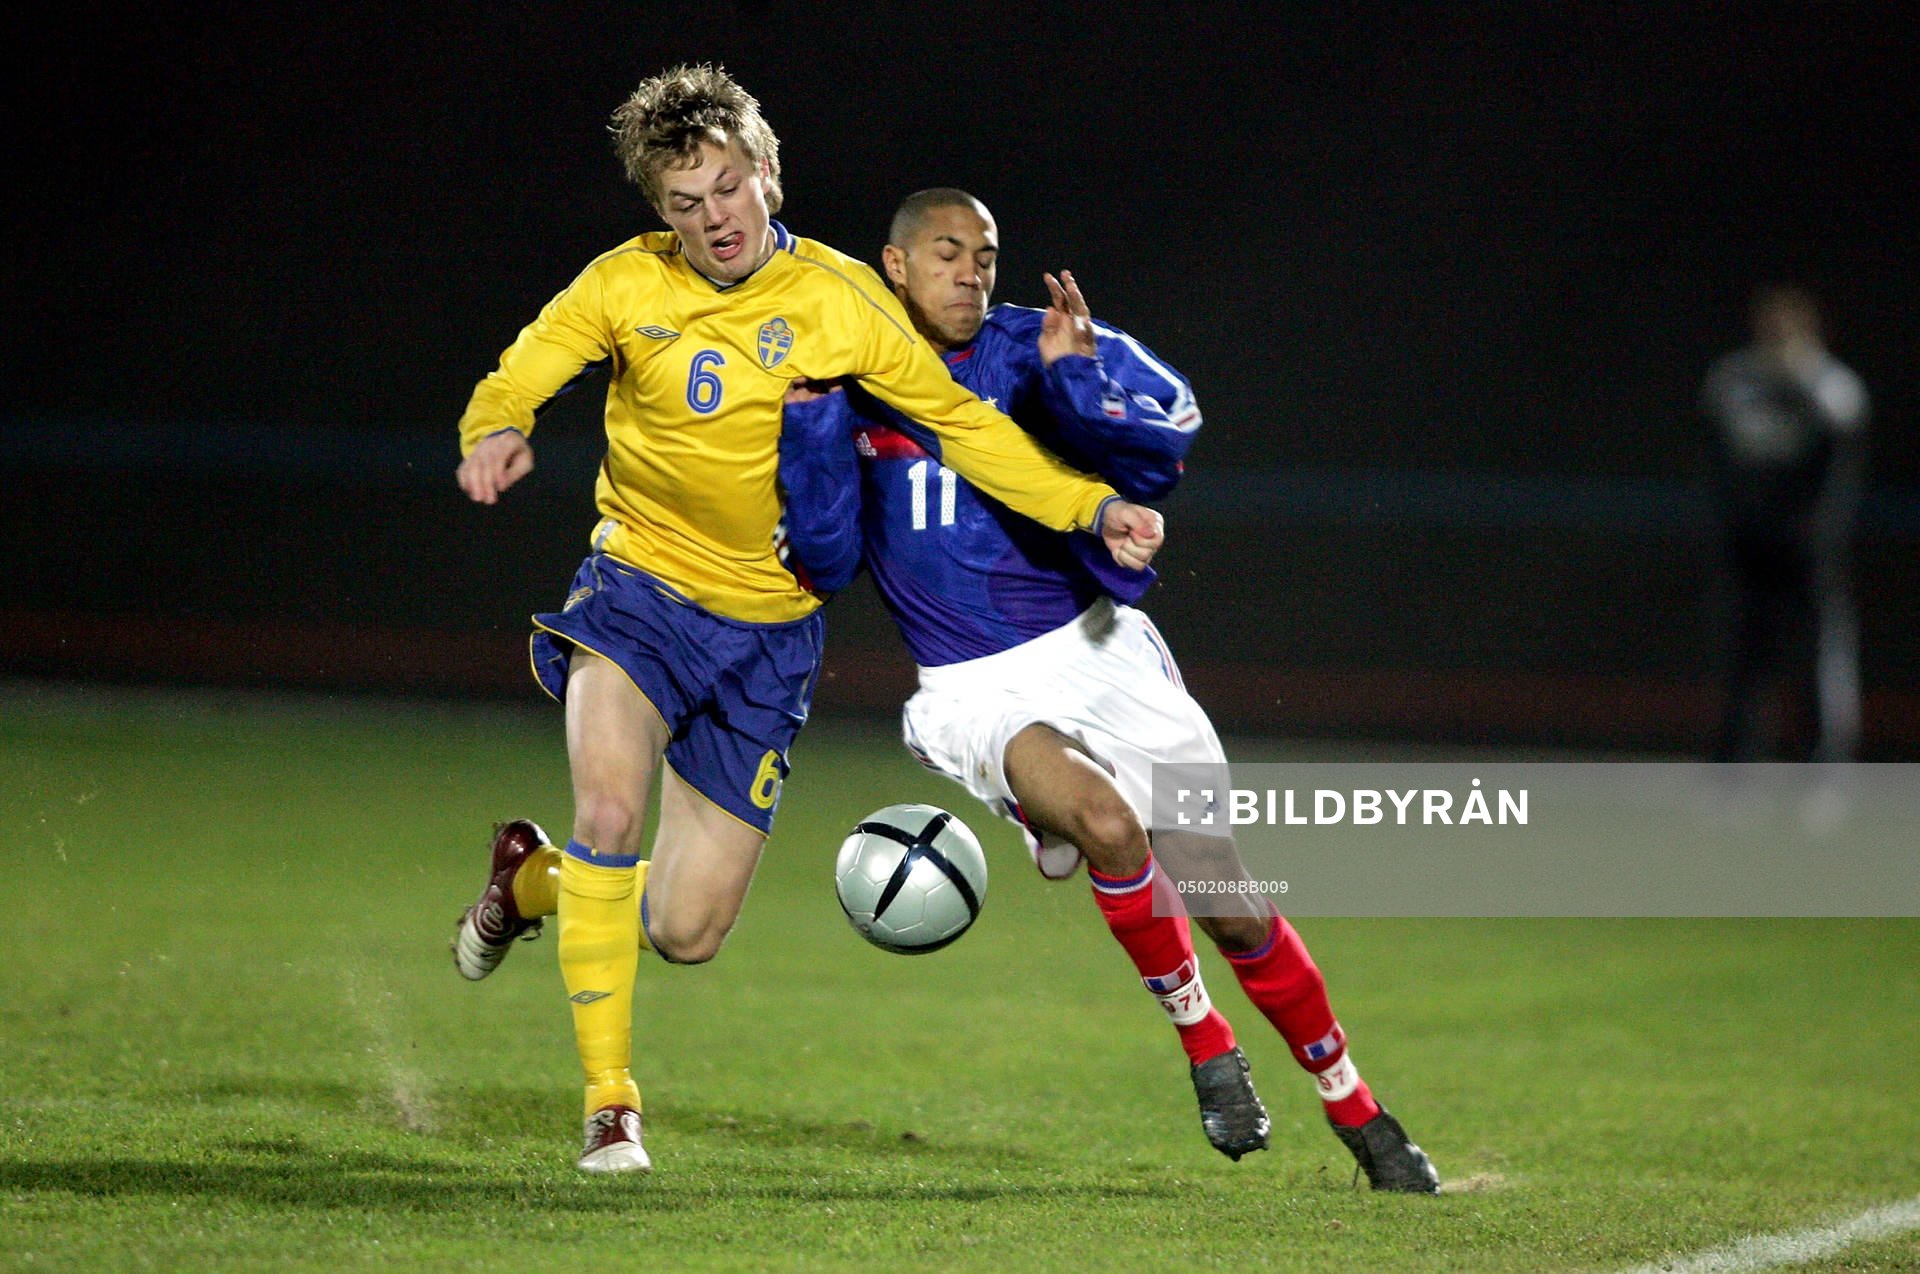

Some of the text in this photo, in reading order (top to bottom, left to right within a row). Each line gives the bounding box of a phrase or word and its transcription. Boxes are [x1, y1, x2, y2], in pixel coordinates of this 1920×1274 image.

[686, 348, 726, 414] 6
[908, 460, 957, 530] 11
[750, 749, 780, 809] 6
